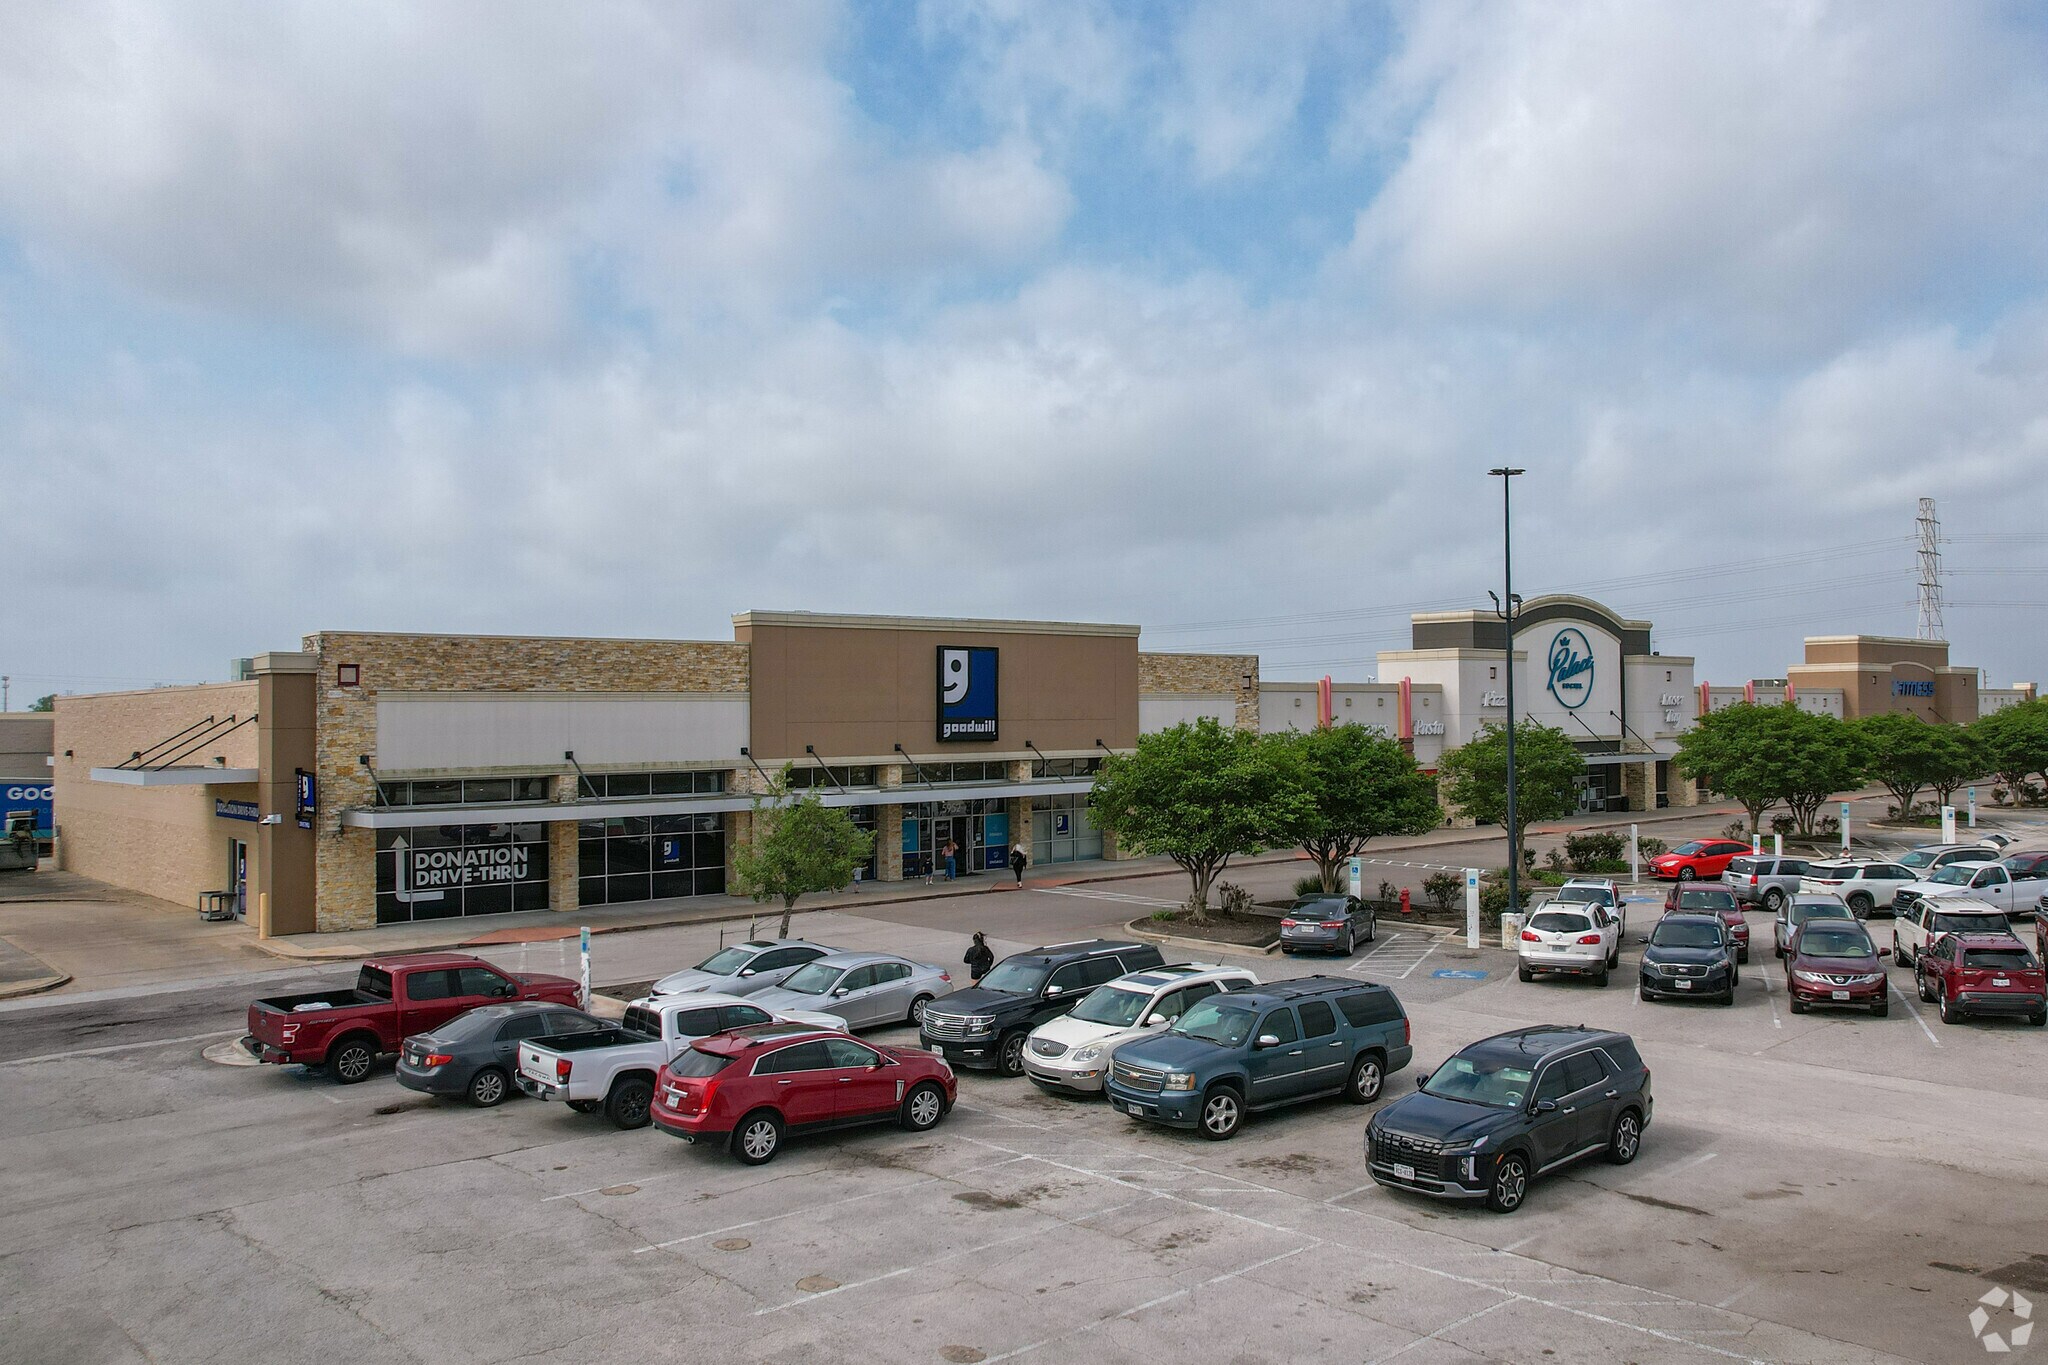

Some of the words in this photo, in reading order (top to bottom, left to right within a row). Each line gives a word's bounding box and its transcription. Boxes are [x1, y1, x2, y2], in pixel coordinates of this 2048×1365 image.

[1546, 647, 1595, 690] Palace
[1483, 690, 1507, 707] Pizz
[943, 720, 996, 738] goodwill
[1413, 719, 1445, 736] Pasta
[415, 846, 528, 869] DONATION
[416, 863, 528, 886] DRIVE-THRU
